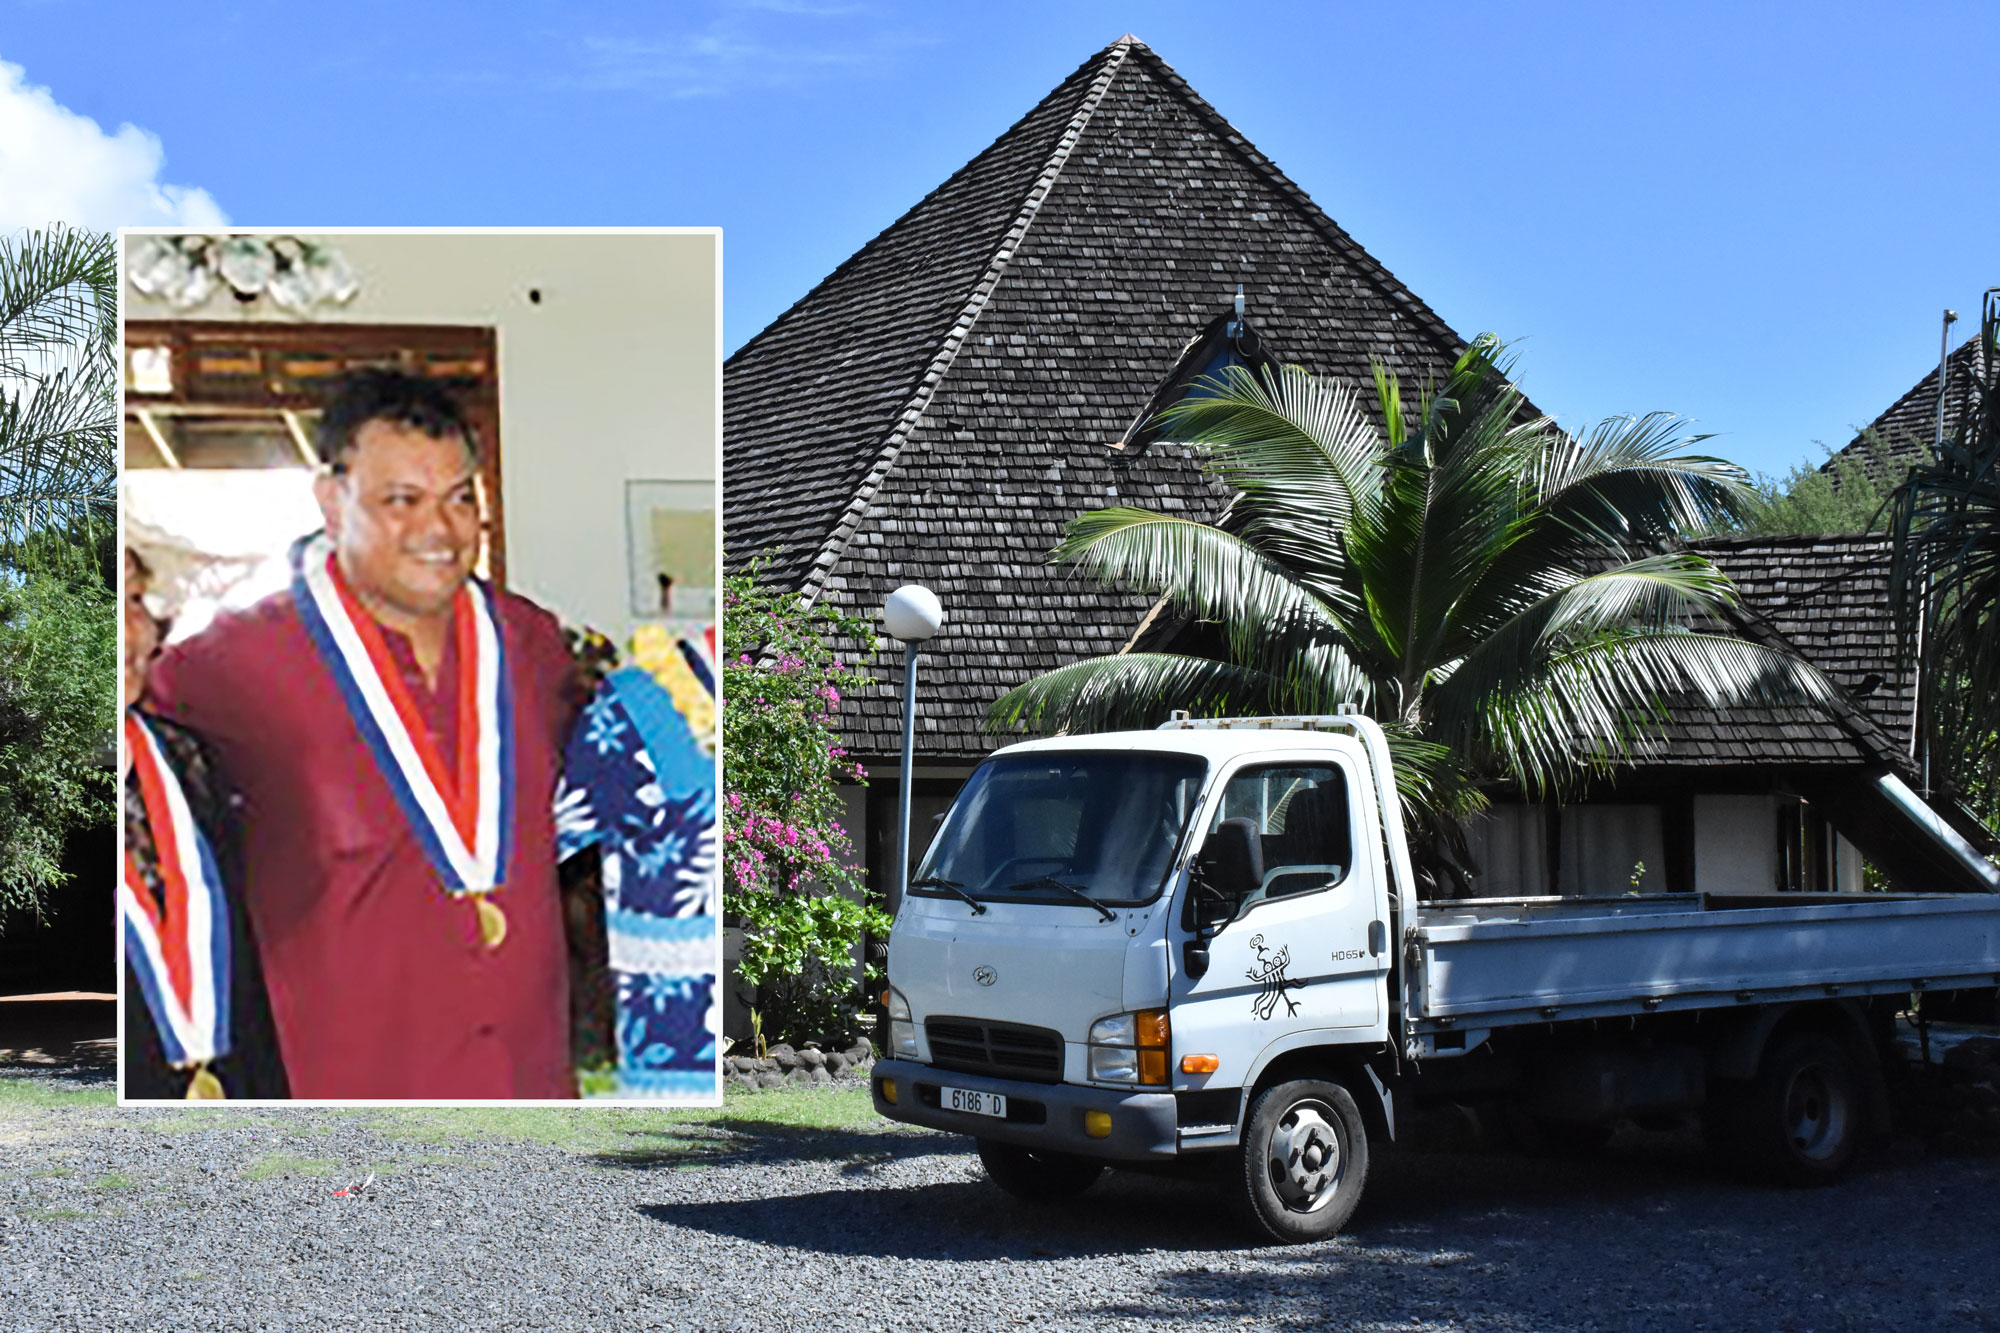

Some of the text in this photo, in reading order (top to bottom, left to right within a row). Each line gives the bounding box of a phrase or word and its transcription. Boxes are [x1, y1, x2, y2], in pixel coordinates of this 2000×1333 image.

[1331, 950, 1358, 961] HD65
[952, 1090, 1001, 1114] 6186 D
